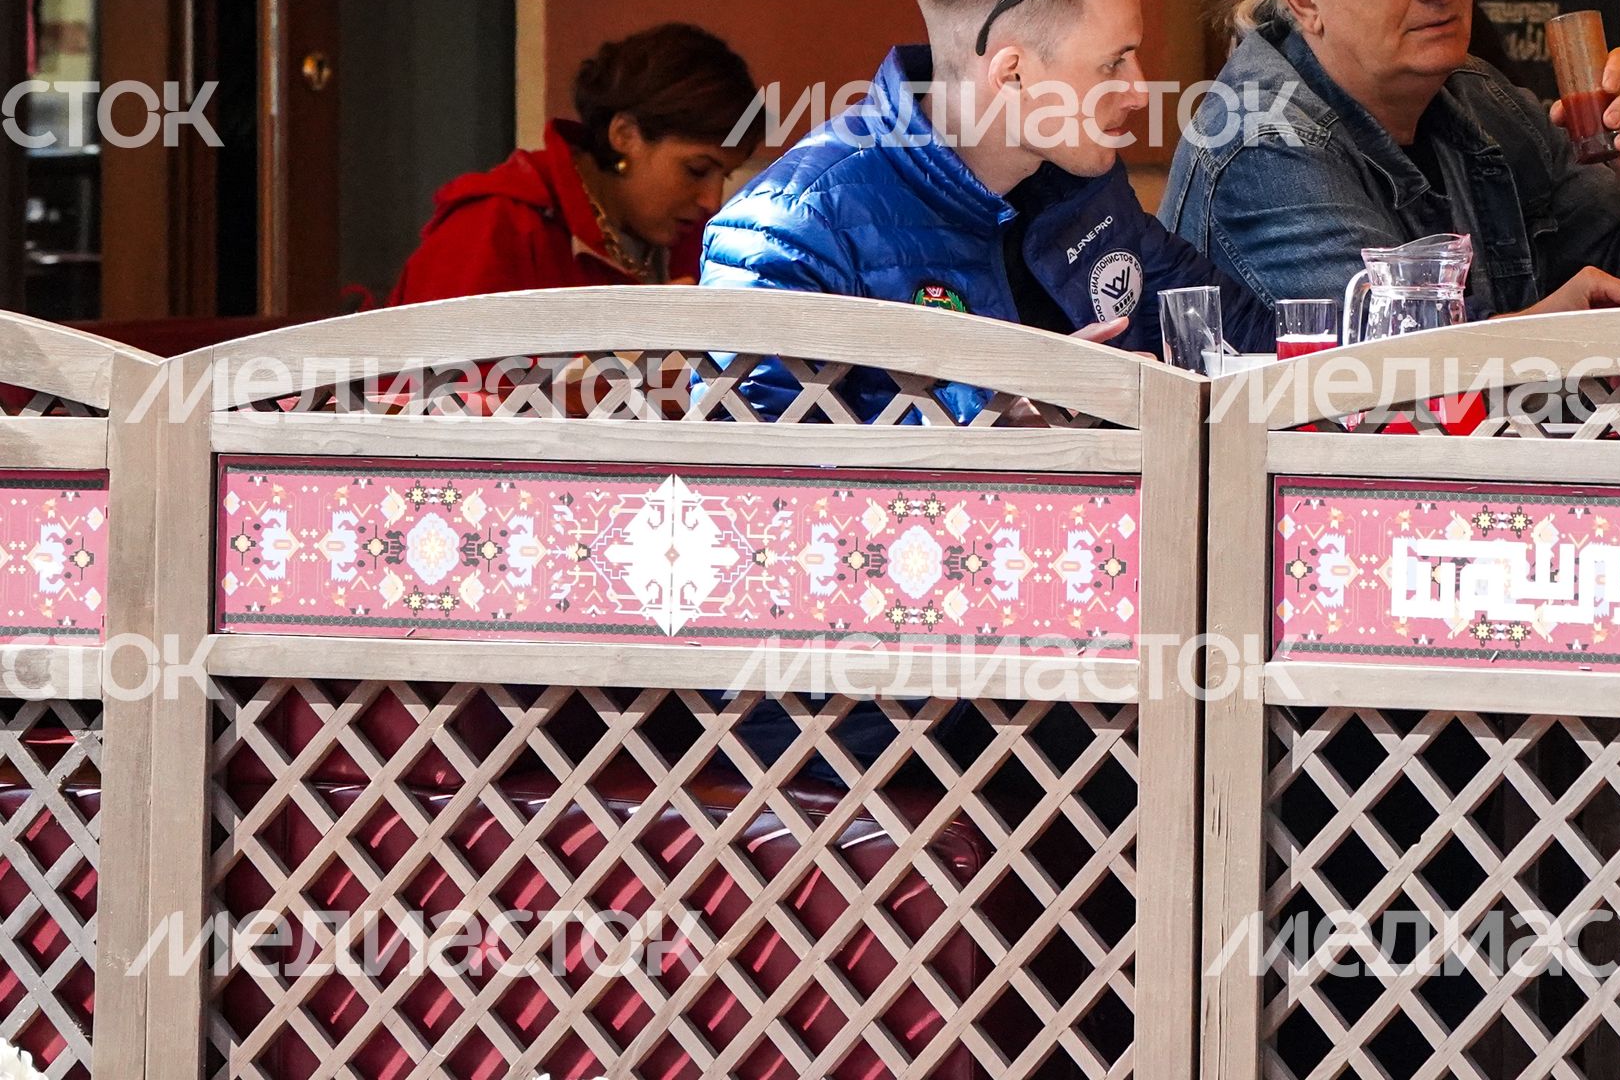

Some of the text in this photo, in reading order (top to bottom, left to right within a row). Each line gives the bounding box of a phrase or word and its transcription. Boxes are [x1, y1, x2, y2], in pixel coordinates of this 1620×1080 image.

[1094, 215, 1114, 235] PRO
[1090, 253, 1134, 295] БИАТЛОНИСТОВ
[1094, 298, 1106, 322] ОЮЗ
